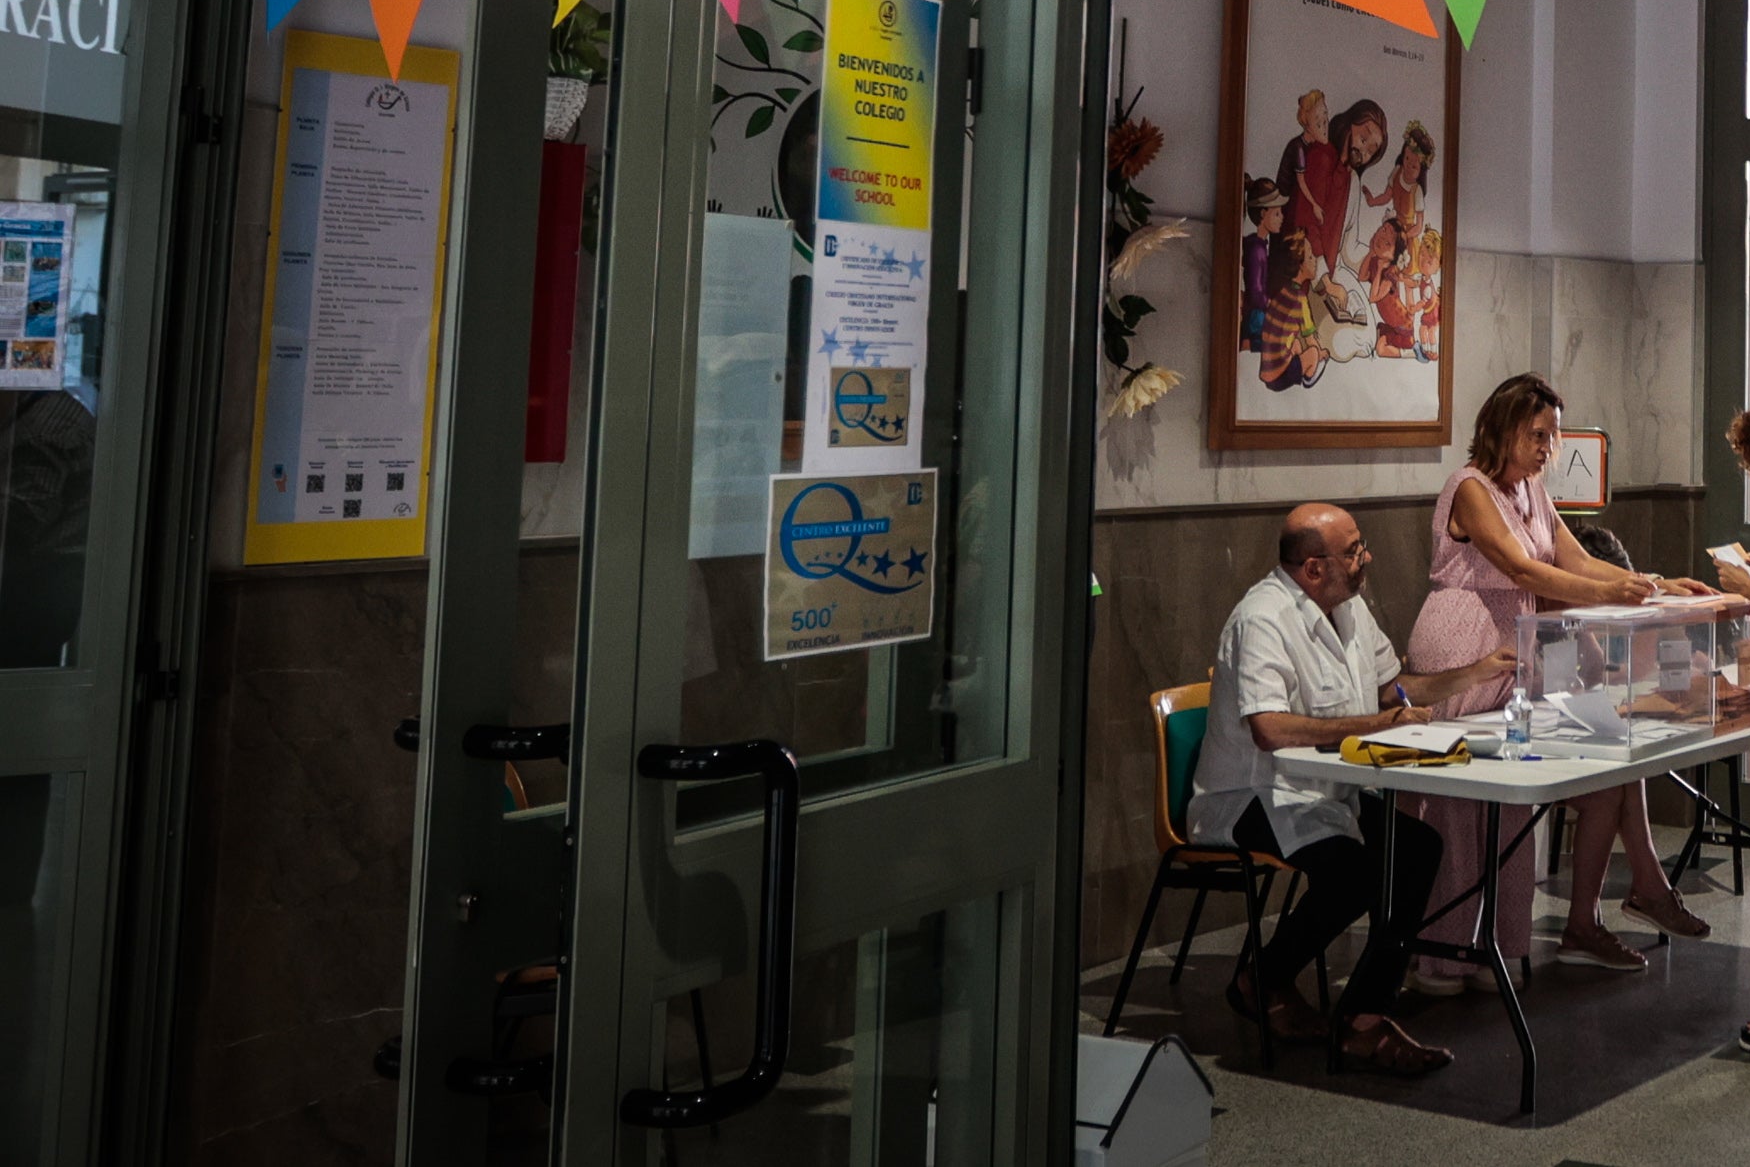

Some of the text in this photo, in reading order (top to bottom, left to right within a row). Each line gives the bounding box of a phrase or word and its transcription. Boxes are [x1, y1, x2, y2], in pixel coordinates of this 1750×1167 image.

[838, 53, 925, 84] BIENVENIDOS A
[854, 78, 908, 101] NUESTRO
[854, 100, 905, 122] COLEGIO
[828, 167, 922, 191] WELCOME TO OUR
[855, 188, 896, 207] SCHOOL
[1566, 449, 1592, 477] A
[792, 520, 886, 538] CENTRO EXCELENTE
[786, 634, 840, 651] EXCELENCIA
